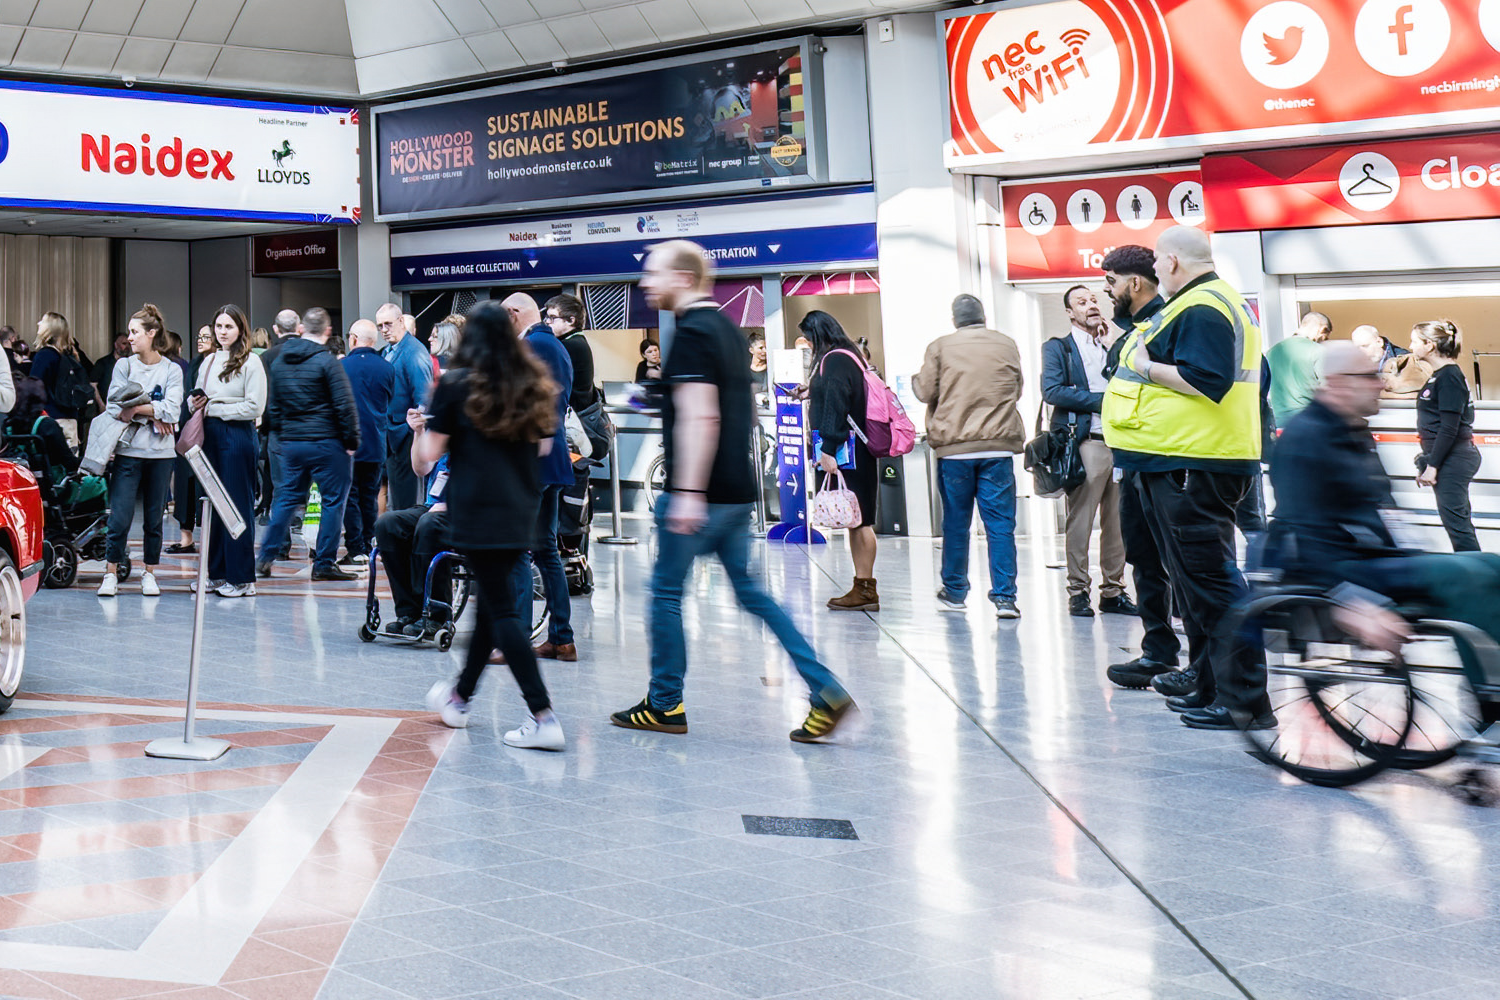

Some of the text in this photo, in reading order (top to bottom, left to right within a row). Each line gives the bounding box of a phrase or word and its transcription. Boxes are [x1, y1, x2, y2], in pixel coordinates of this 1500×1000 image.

[982, 30, 1046, 82] nec
[1002, 46, 1090, 114] WiFi
[1008, 63, 1032, 81] free
[1263, 97, 1316, 111] @thenec
[258, 117, 308, 128] Headline Partner
[487, 101, 609, 136] SUSTAINABLE
[390, 130, 474, 155] HOLLYWOOD
[487, 116, 685, 161] SIGNAGE SOLUTIONS
[81, 133, 236, 181] Naidex
[390, 145, 475, 176] MONSTER
[708, 159, 721, 168] nec
[722, 158, 742, 168] group
[421, 172, 440, 181] CREATE
[487, 156, 613, 180] hollywoodmonster.co.uk
[258, 169, 311, 186] LLOYDS
[509, 231, 538, 242] Naidex
[587, 226, 621, 235] CONVENTION
[265, 244, 326, 260] Organisers Office
[702, 245, 757, 261] GISTRATION
[423, 261, 520, 277] VISITOR BADGE COLLECTION
